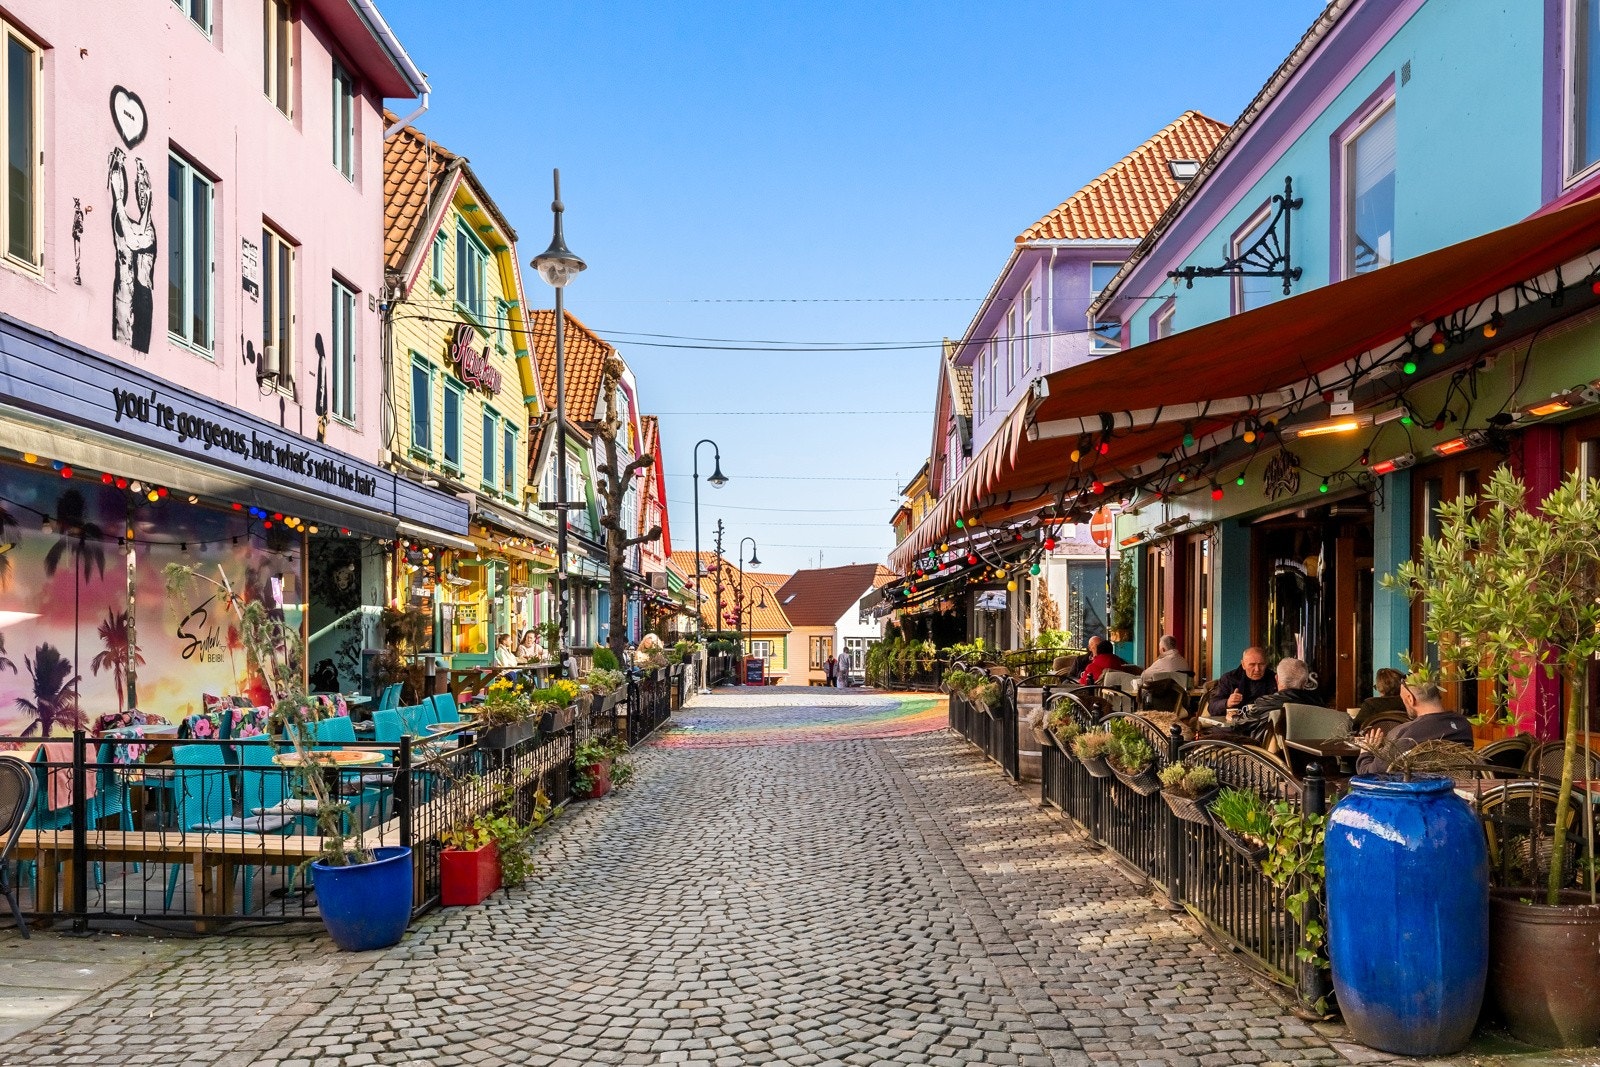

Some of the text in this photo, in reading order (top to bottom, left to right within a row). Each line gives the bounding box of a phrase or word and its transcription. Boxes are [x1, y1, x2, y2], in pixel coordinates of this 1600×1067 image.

[113, 387, 376, 497] you're gorgeous, but what's with the hair?
